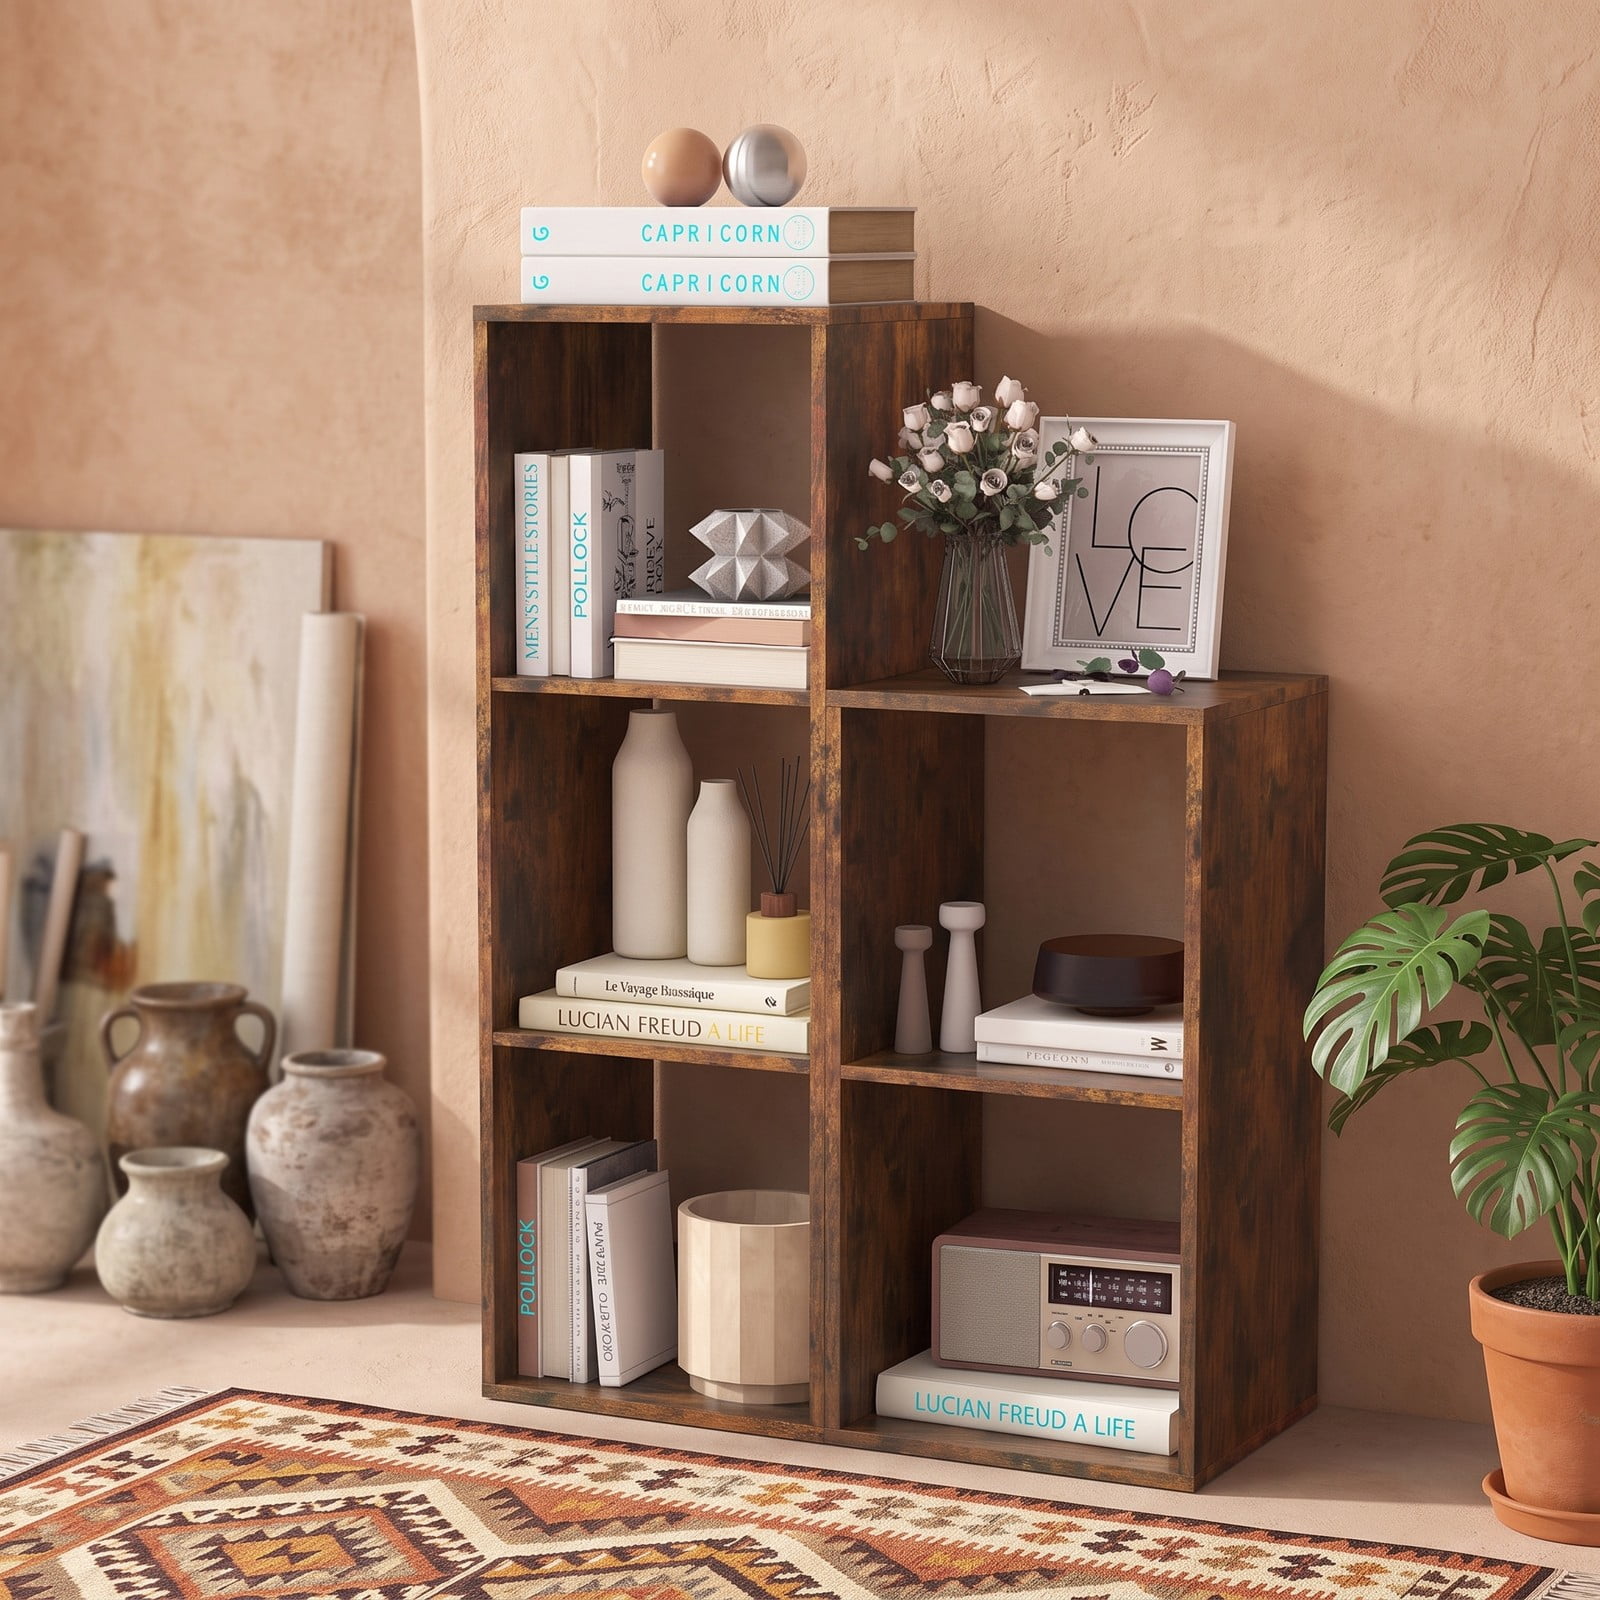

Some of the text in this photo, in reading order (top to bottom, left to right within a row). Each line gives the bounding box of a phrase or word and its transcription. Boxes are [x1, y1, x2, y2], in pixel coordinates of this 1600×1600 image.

[640, 224, 781, 243] CAPRICORN
[640, 272, 781, 293] CAPRICORN
[573, 512, 588, 618] POLLOCK
[605, 980, 617, 992] Le
[558, 1008, 765, 1044] LUCIAN FREUD A LIFE
[519, 1219, 536, 1316] POLLOCK
[915, 1392, 1136, 1440] LUCIAN FREUD A LIFE
